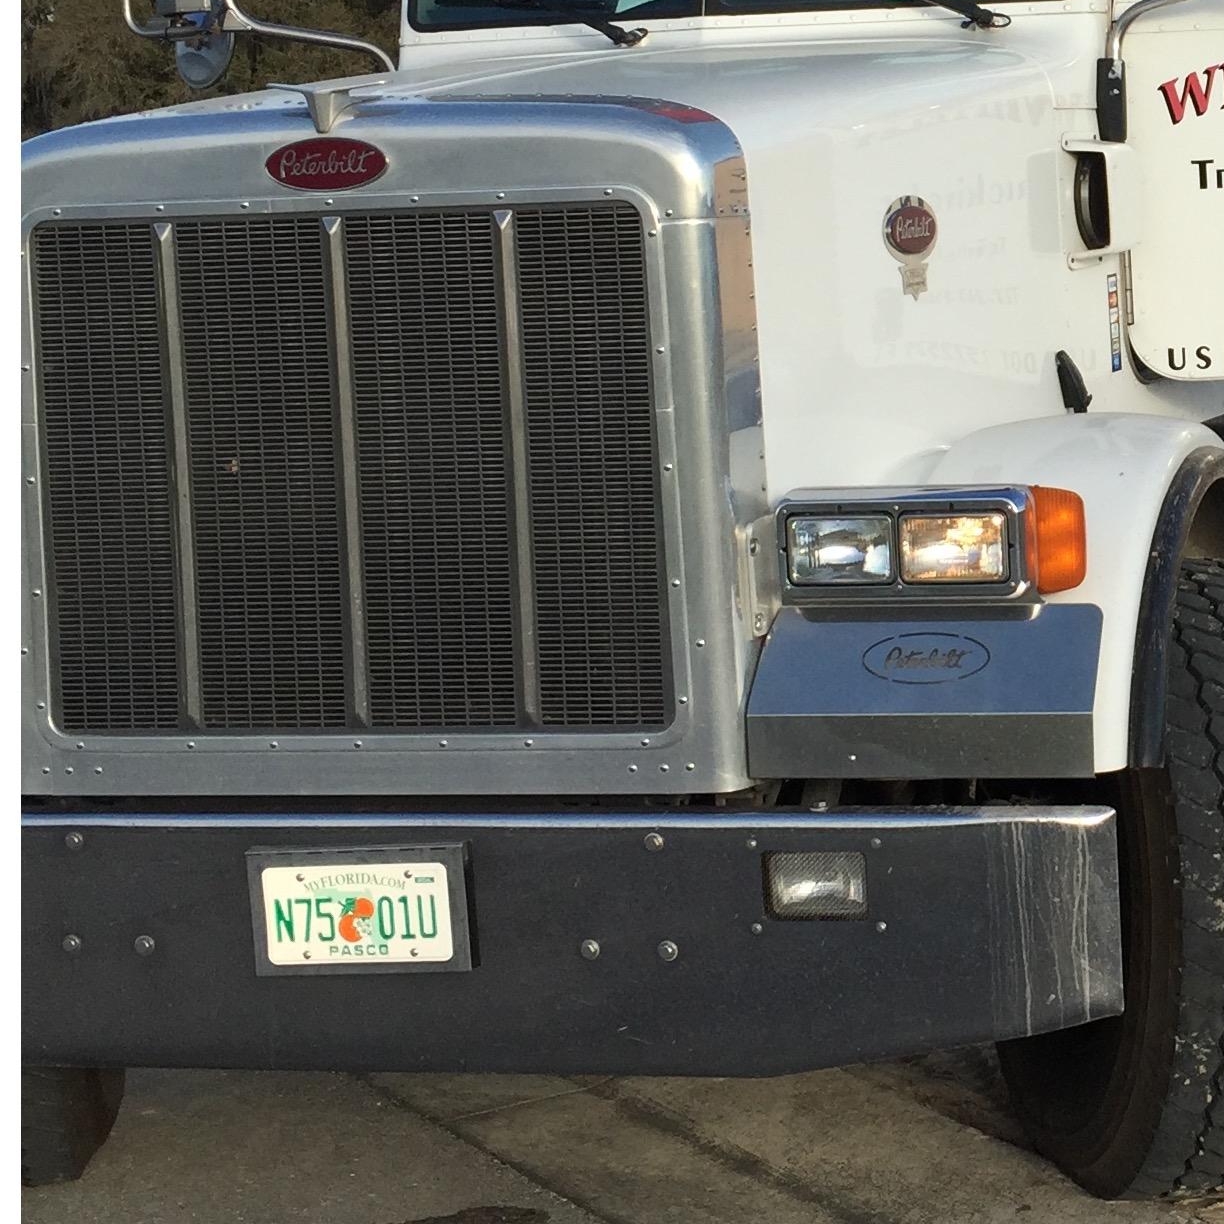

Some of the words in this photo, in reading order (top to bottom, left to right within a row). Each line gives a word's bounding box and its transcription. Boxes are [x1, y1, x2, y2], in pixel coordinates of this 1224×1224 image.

[279, 149, 376, 179] Peterbilt
[1167, 345, 1212, 371] US
[884, 646, 973, 670] Peterbilt
[303, 872, 406, 892] MYFLORIDA.COM
[274, 897, 336, 943] N75
[329, 944, 389, 956] PASCO
